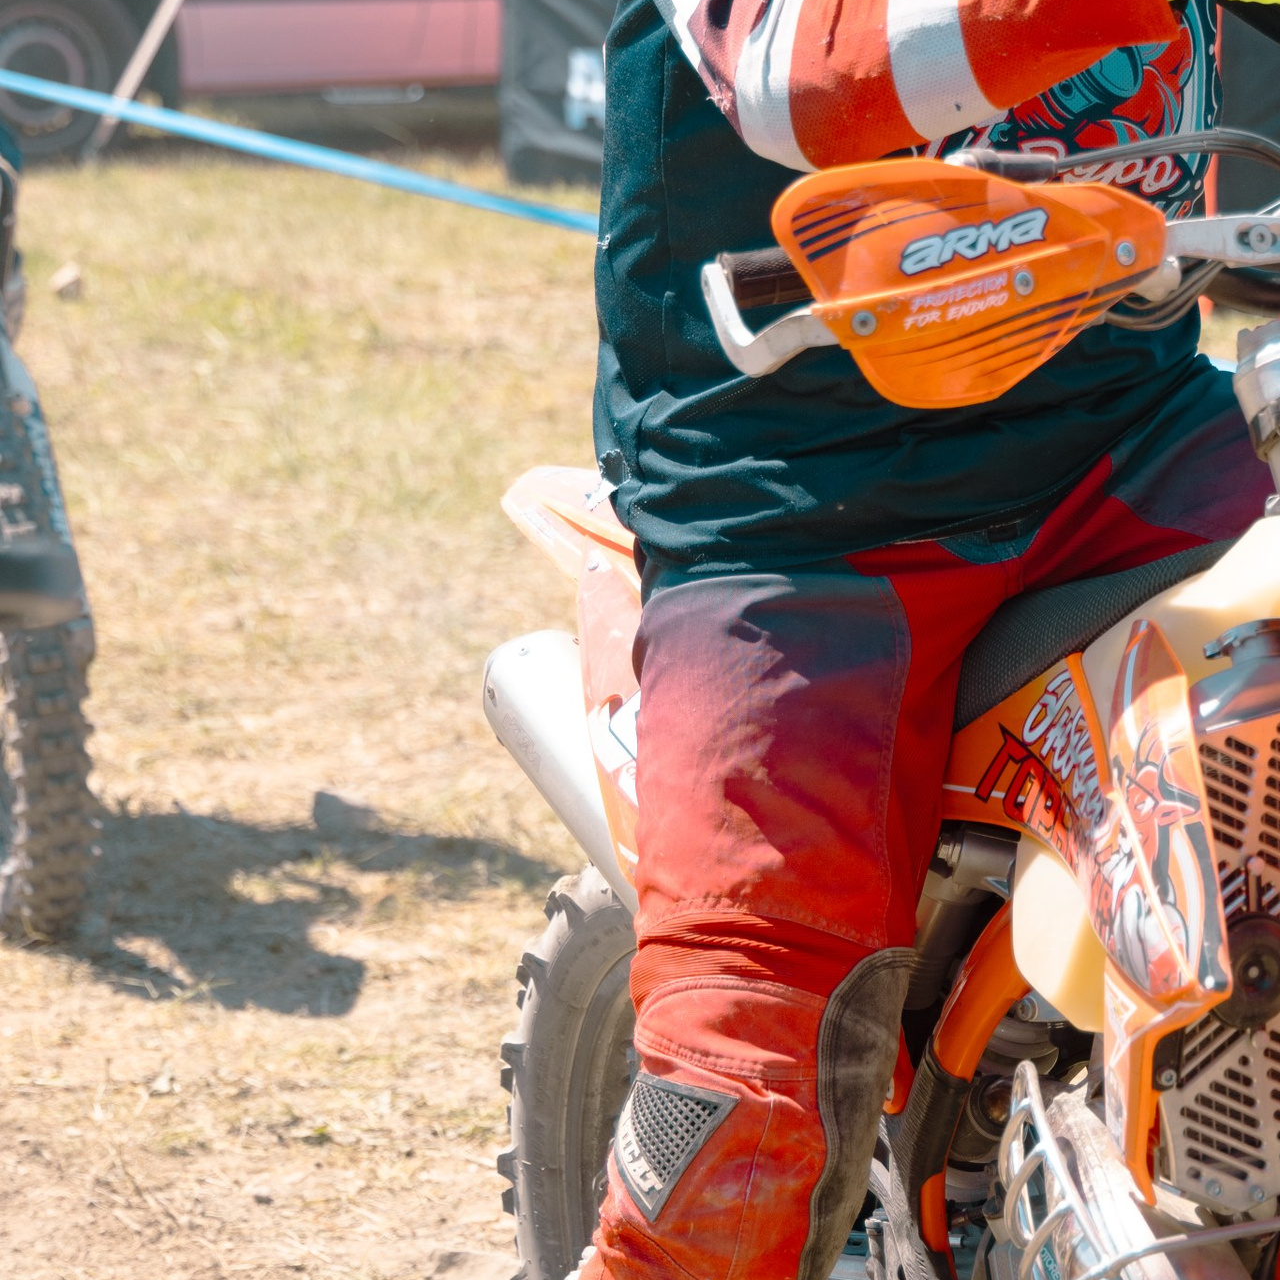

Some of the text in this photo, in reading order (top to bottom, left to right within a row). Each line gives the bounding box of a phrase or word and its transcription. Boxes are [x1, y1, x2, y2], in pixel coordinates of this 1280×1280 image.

[904, 292, 1009, 331] FOR ENDURO
[911, 272, 1009, 313] PROTECTION
